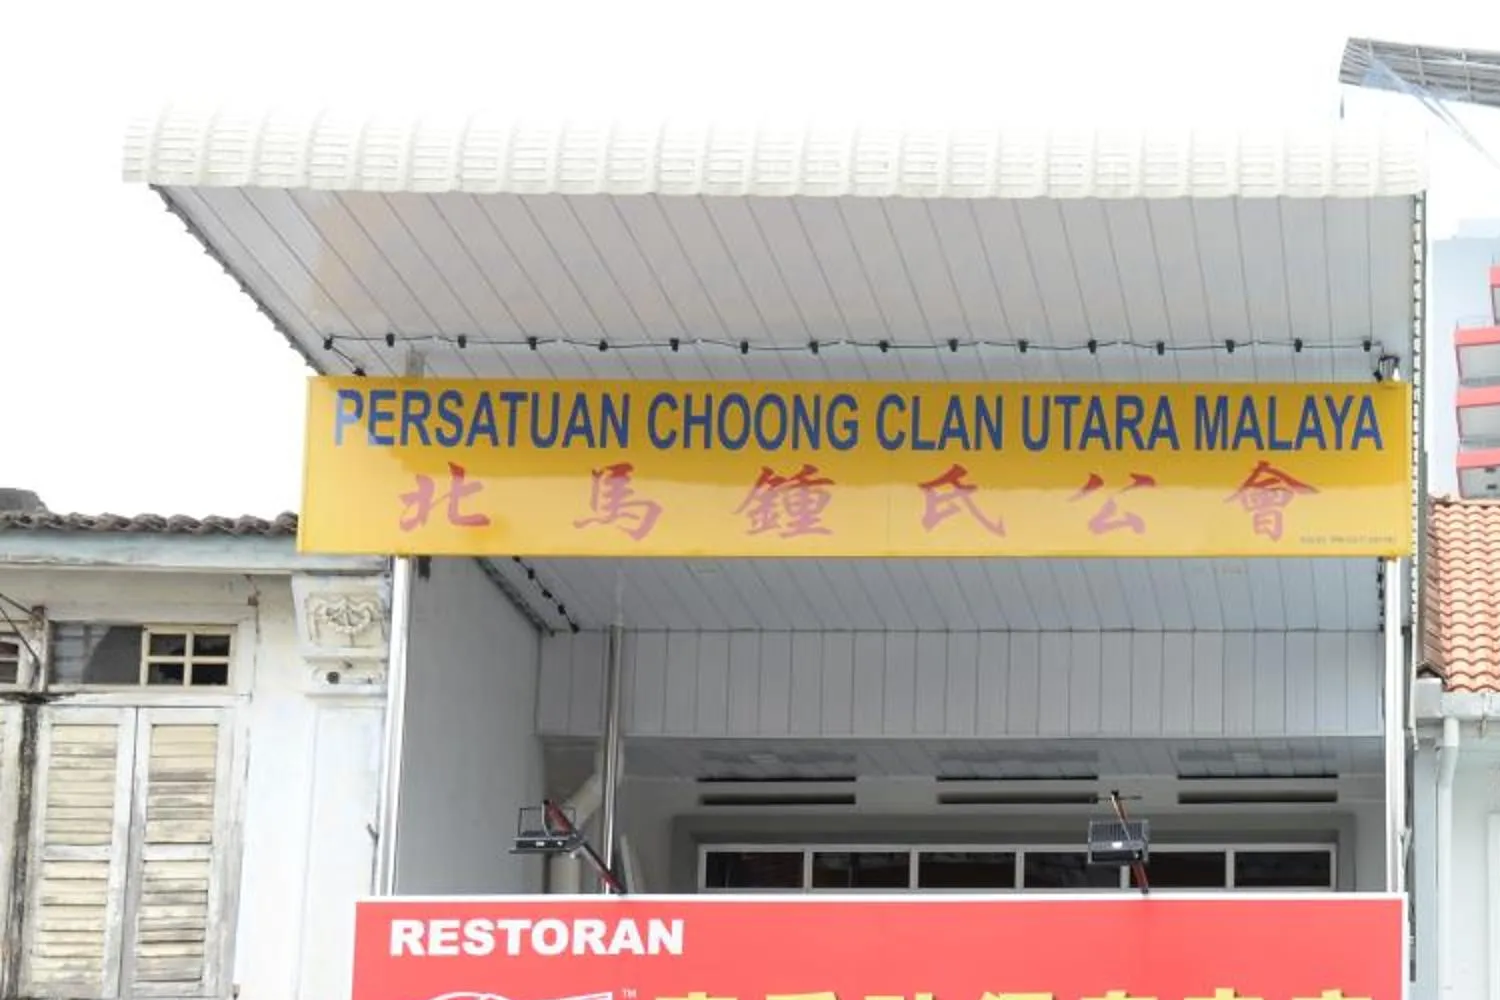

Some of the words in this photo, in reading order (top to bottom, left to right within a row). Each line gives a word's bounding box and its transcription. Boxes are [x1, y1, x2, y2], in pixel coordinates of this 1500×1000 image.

[334, 389, 630, 449] PERSATUAN
[647, 393, 858, 450] CHOONG
[876, 394, 1002, 451] CLAN
[1021, 395, 1179, 451] UTARA
[1194, 395, 1384, 451] MALAYA
[390, 919, 684, 956] RESTORAN
